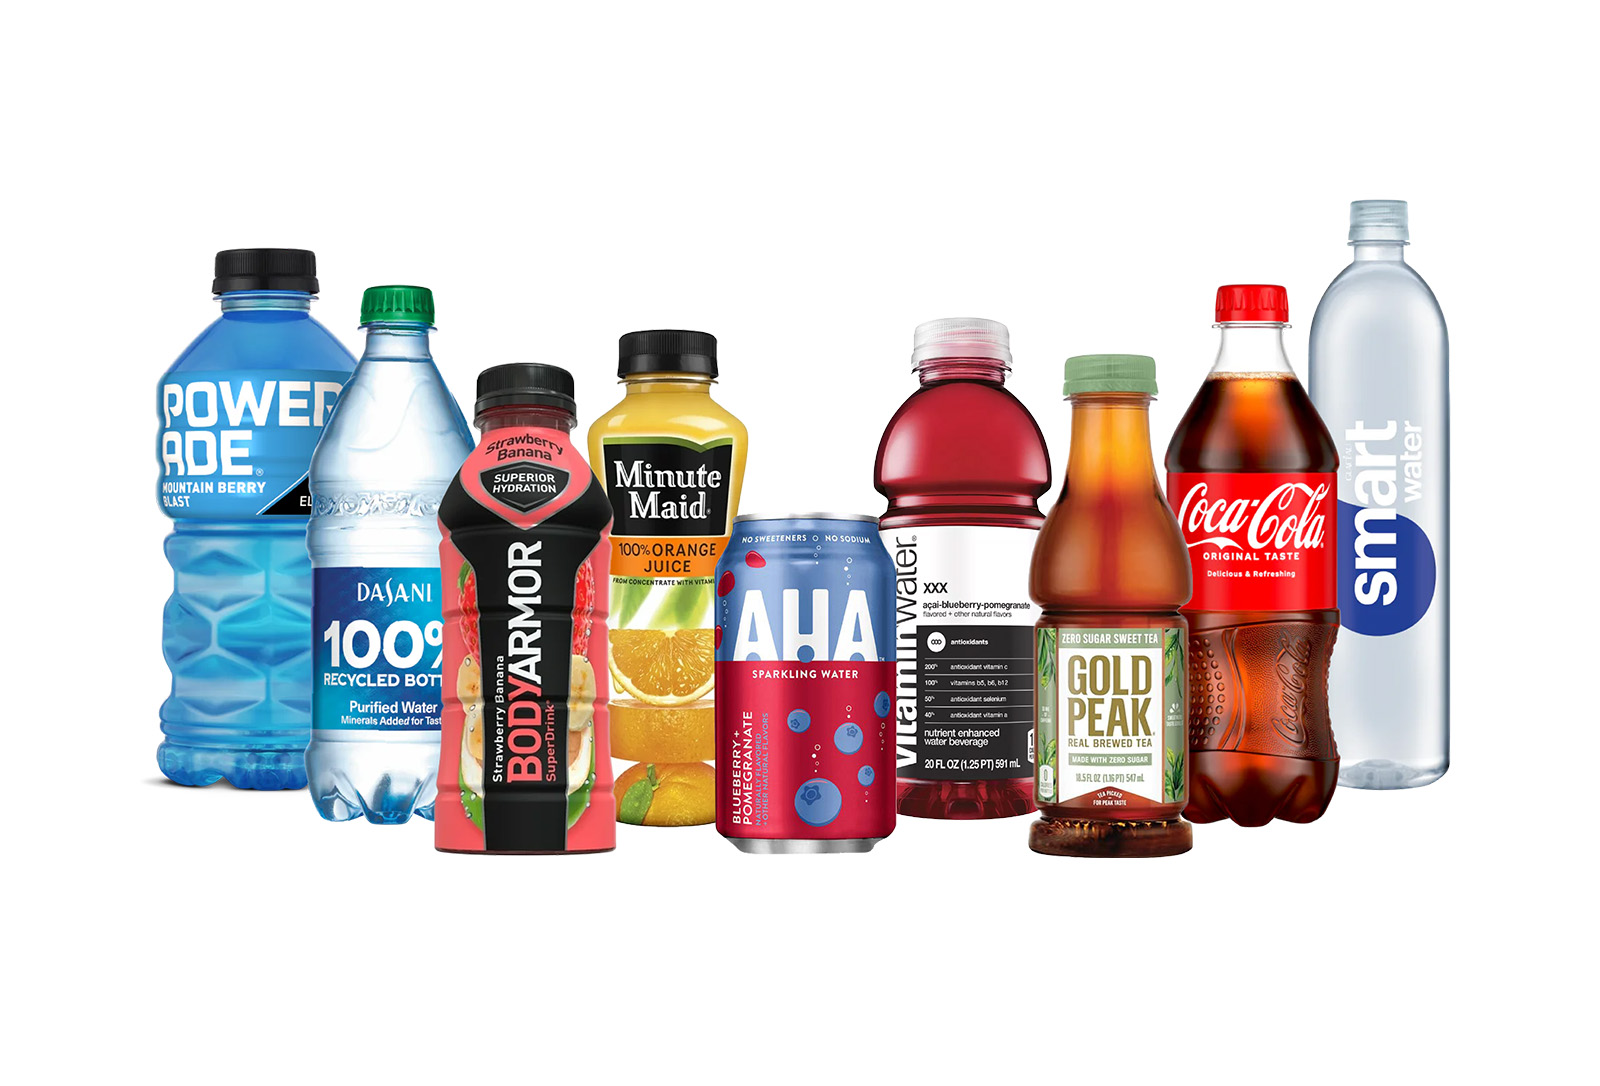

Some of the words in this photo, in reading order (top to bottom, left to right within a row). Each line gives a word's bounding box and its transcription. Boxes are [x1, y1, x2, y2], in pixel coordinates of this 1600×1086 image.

[163, 380, 343, 428] POWER
[485, 433, 563, 455] Strawberry
[162, 430, 253, 476] ADE
[497, 448, 552, 461] Banana
[1400, 420, 1422, 503] water
[493, 472, 556, 483] SUPERIOR
[613, 460, 722, 488] Minute
[162, 482, 214, 494] MOUNTAIN
[218, 482, 267, 494] BERRY
[492, 484, 557, 494] HYDRATION
[162, 495, 190, 508] BLAST
[627, 491, 708, 519] Maid
[1178, 482, 1331, 549] Coca-Cola
[1345, 420, 1398, 606] smart
[741, 536, 753, 544] NO
[754, 534, 807, 543] SWEETENERS
[840, 535, 871, 544] SODIUM
[618, 543, 651, 556] 100%
[652, 543, 717, 556] ORANGE
[1203, 552, 1260, 561] ORIGINAL
[1264, 552, 1300, 561] TASTE
[644, 560, 691, 573] JUICE
[1207, 570, 1243, 578] Delicious
[1245, 570, 1250, 578] &
[1253, 570, 1296, 578] Refreshing
[612, 577, 628, 585] FROM
[628, 578, 676, 586] CONCENTRATE
[357, 577, 432, 607] DASANI
[922, 600, 1031, 611] açai-blueberry-pomegranate
[733, 588, 879, 662] AHA
[950, 638, 989, 646] antioxidants
[1061, 633, 1081, 644] ZERO
[1083, 633, 1111, 644] SUGAR
[1113, 633, 1142, 644] SWEET
[1144, 633, 1158, 644] TEA
[507, 541, 542, 783] BODYARMOR
[323, 673, 400, 687] RECYCLED
[494, 655, 505, 703] Banana
[752, 669, 817, 679] SPARKLING
[821, 669, 859, 679] WATER
[1067, 654, 1152, 696] GOLD
[349, 700, 398, 714] Purified
[401, 701, 438, 714] Water
[341, 715, 378, 725] Minerals
[380, 716, 410, 726] Added
[411, 716, 423, 725] for
[1067, 697, 1153, 737] PEAK
[734, 730, 740, 738] +
[924, 728, 956, 737] nutrient
[958, 728, 1000, 737] enhanced
[492, 707, 506, 782] Strawberry
[545, 704, 557, 782] SuperDrink
[924, 738, 947, 746] water
[949, 737, 989, 748] beverage
[1068, 738, 1089, 748] REAL
[1093, 738, 1133, 748] BREWED
[1136, 738, 1153, 748] TEA
[924, 759, 934, 769] 20
[935, 759, 945, 769] FL
[947, 759, 960, 769] OZ
[960, 759, 980, 771] (1.25
[980, 759, 994, 771] PT)
[995, 758, 1008, 769] 591
[1009, 758, 1021, 768] mL
[1090, 756, 1107, 764] WITH
[1109, 756, 1126, 764] ZERO
[742, 711, 753, 825] POMEGRANATE
[732, 740, 741, 824] BLUEBERRY
[1087, 773, 1093, 782] FL
[1126, 773, 1136, 782] 547
[1097, 791, 1106, 799] TEA
[1106, 790, 1123, 798] PICKED
